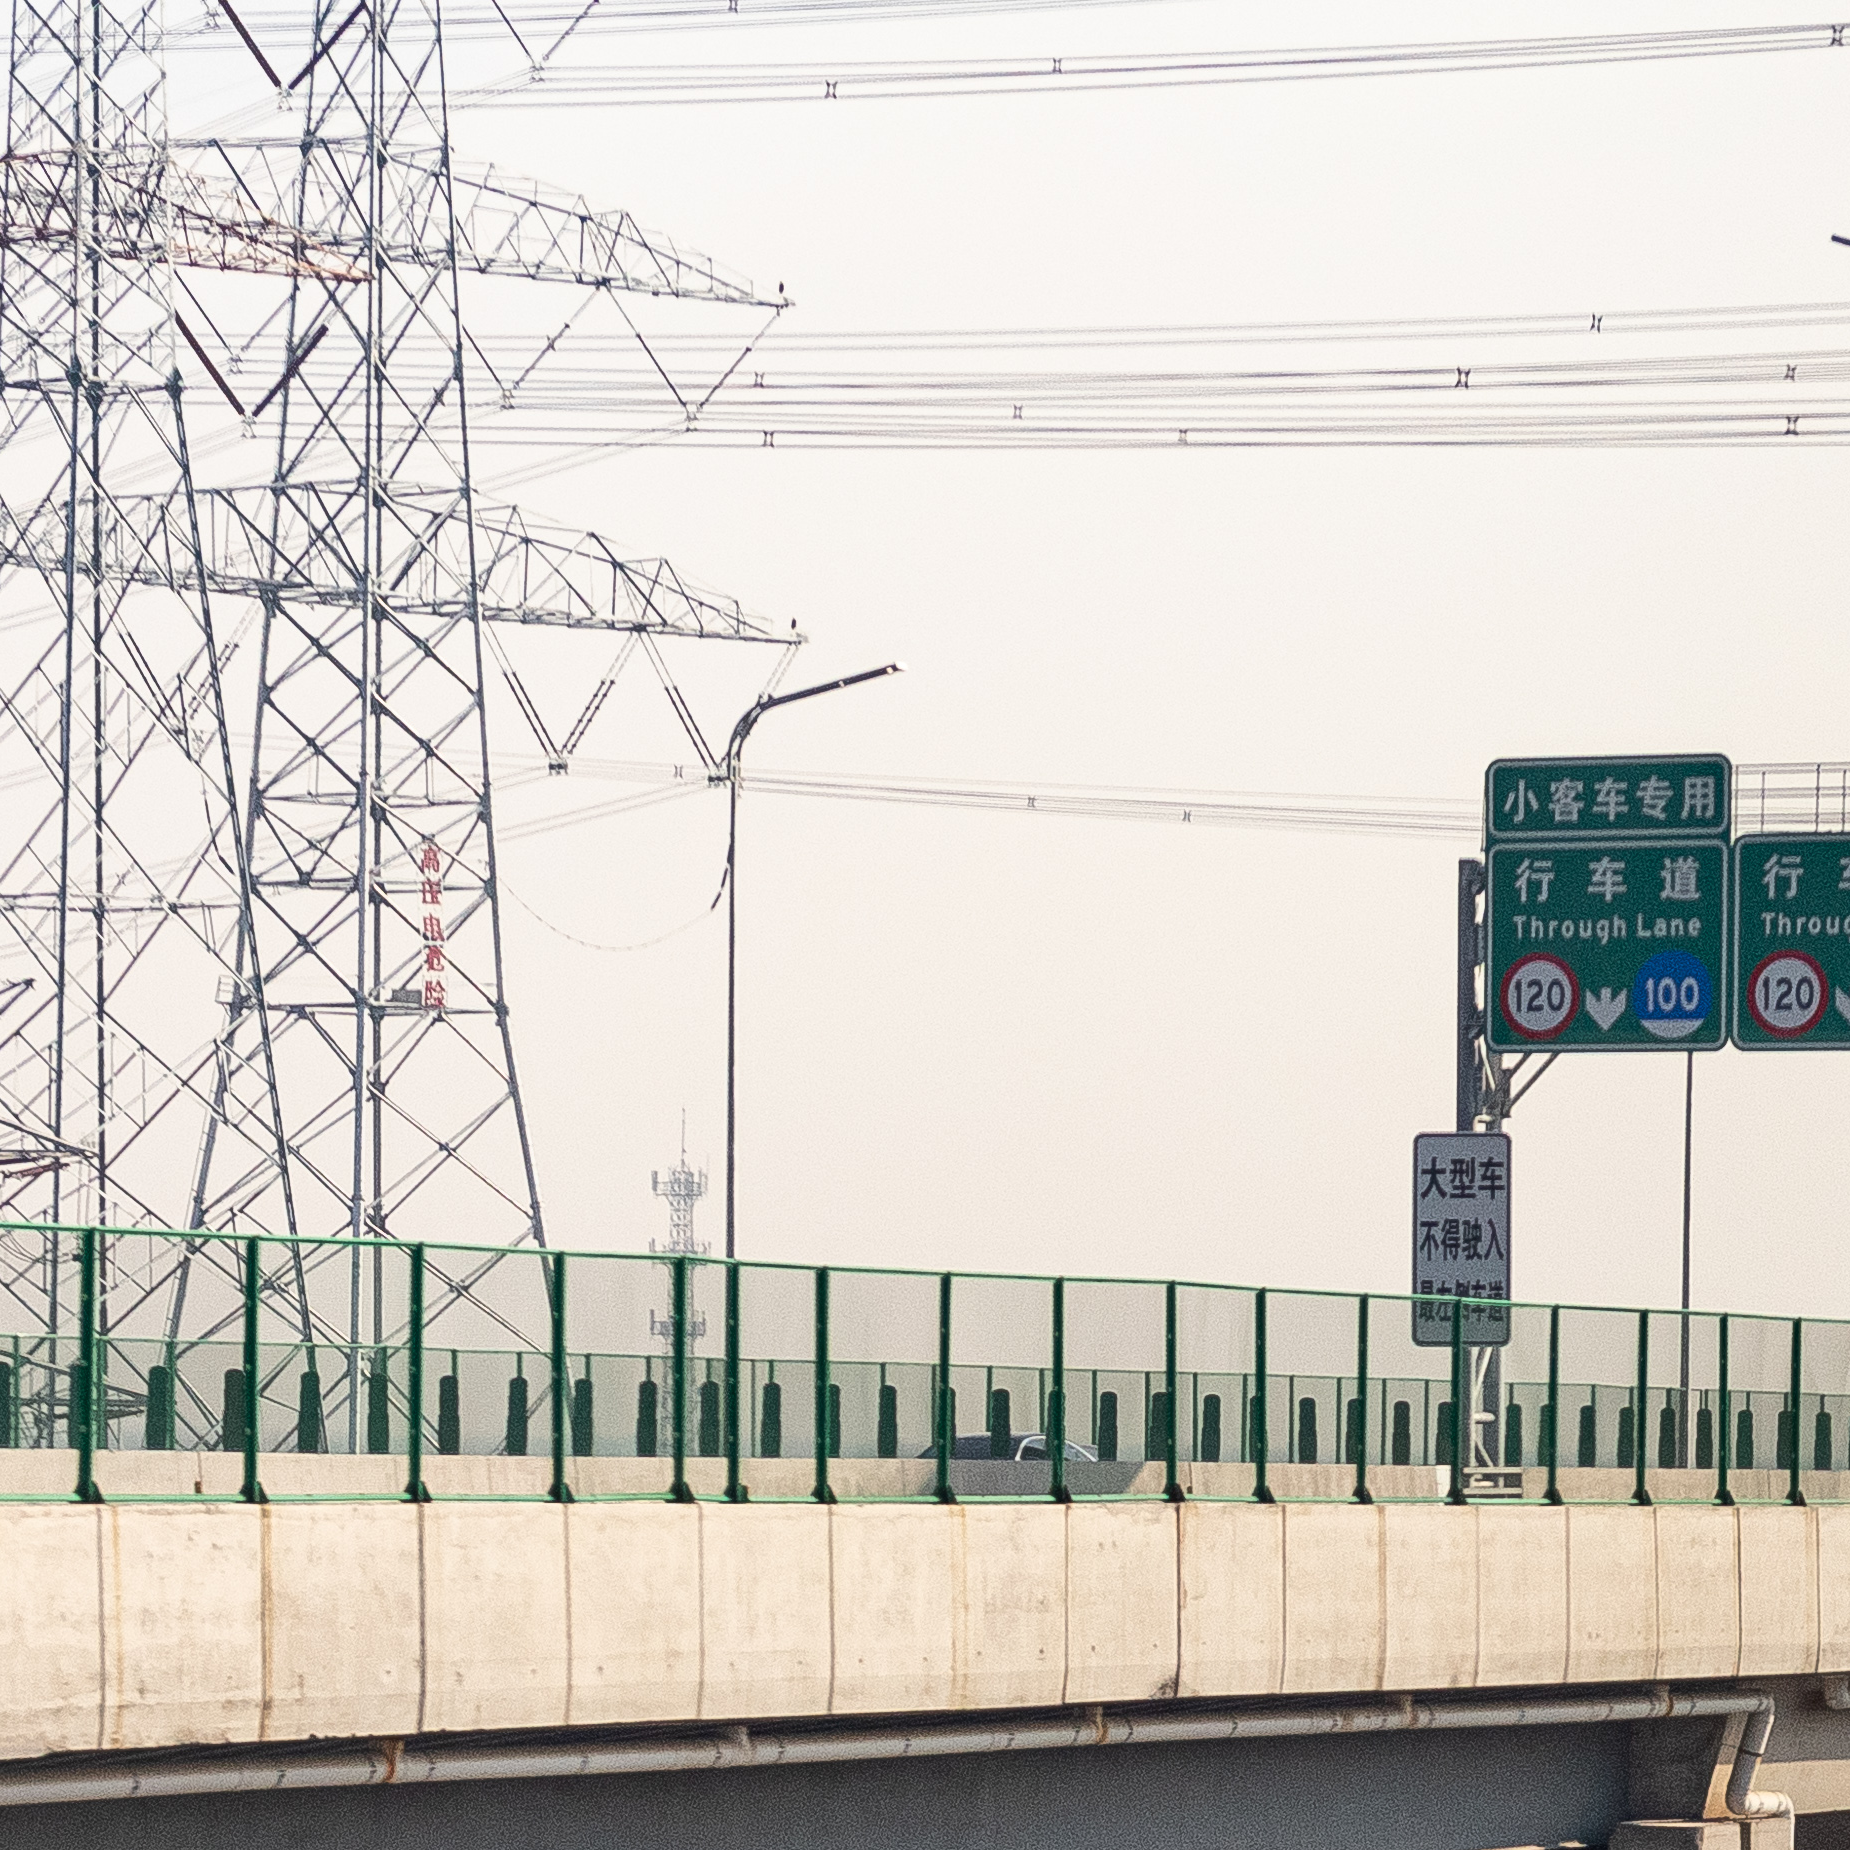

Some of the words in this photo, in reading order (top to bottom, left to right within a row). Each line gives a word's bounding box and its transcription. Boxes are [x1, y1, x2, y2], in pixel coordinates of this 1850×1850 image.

[1504, 775, 1716, 824] 小客车专用
[1515, 856, 1700, 903] 行车道
[1513, 914, 1627, 945] Through
[1636, 913, 1701, 938] Lane
[1514, 978, 1565, 1013] 120
[1645, 976, 1700, 1012] 100
[1762, 975, 1815, 1011] 120
[1420, 1156, 1505, 1200] 大型车
[1420, 1217, 1504, 1261] 不得驶入
